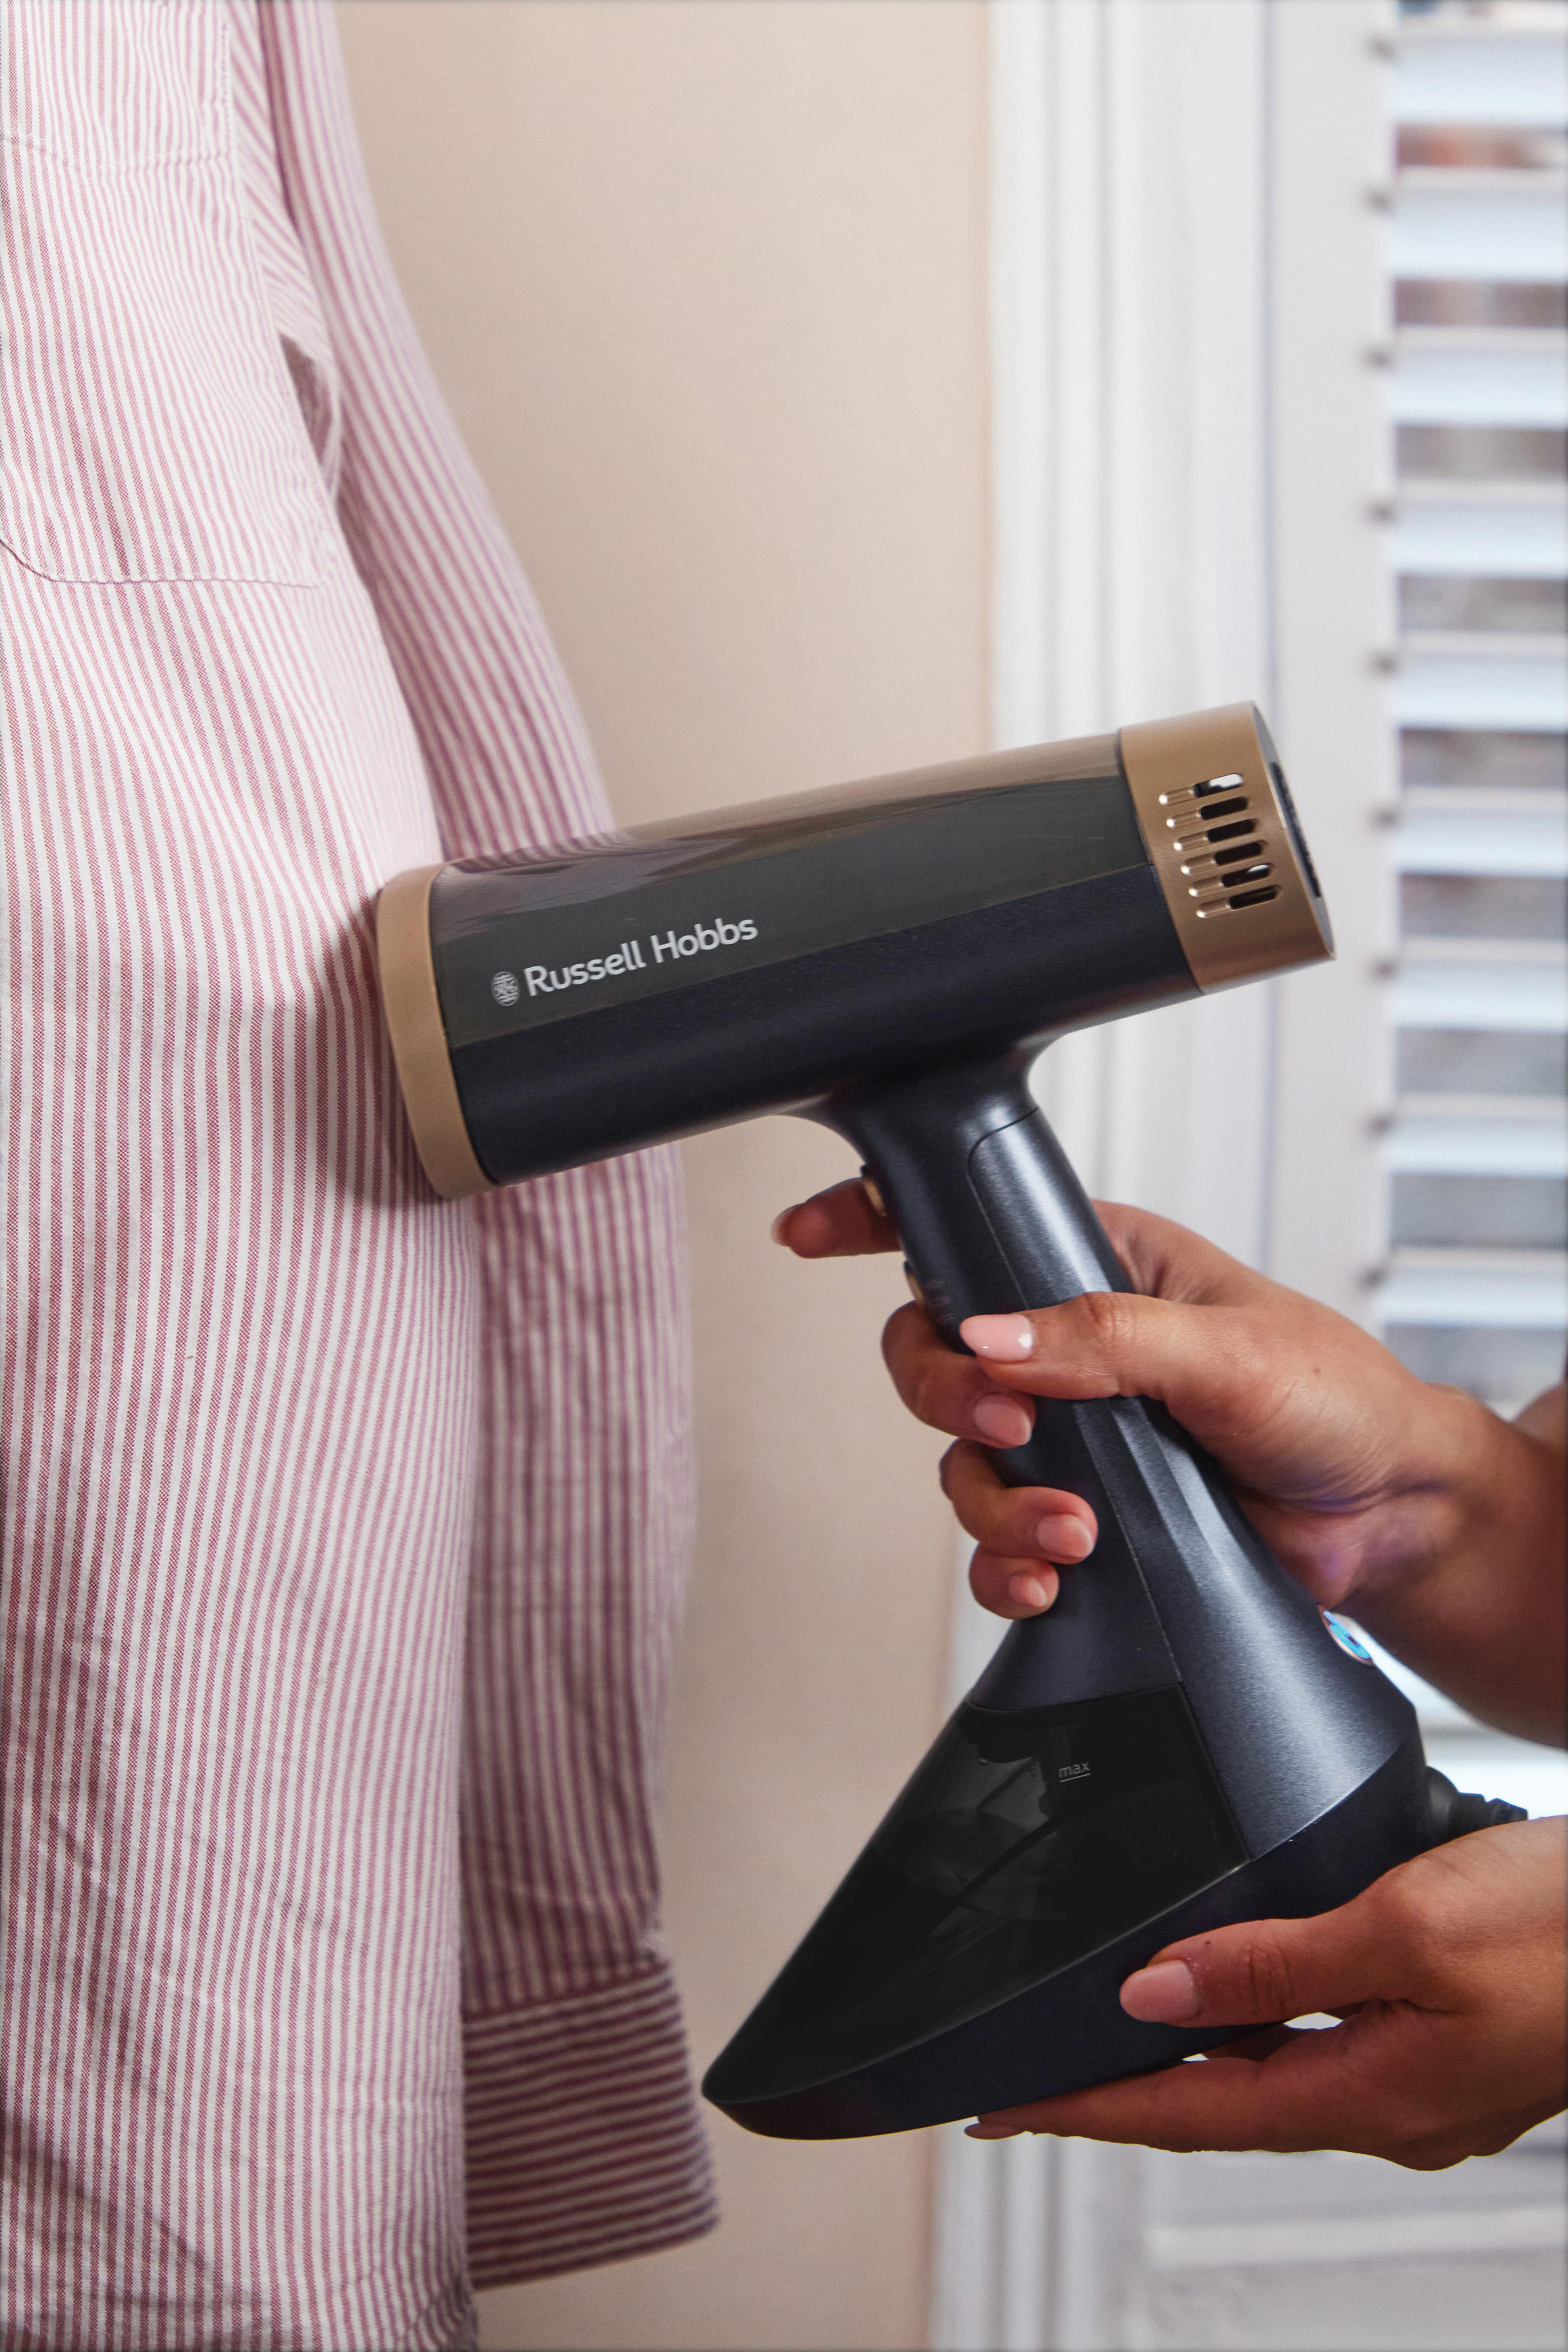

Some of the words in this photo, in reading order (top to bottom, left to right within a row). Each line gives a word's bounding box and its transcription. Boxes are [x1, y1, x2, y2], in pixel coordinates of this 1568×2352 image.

[524, 940, 647, 996] Russell
[650, 918, 758, 963] Hobbs
[1059, 1761, 1090, 1778] max
